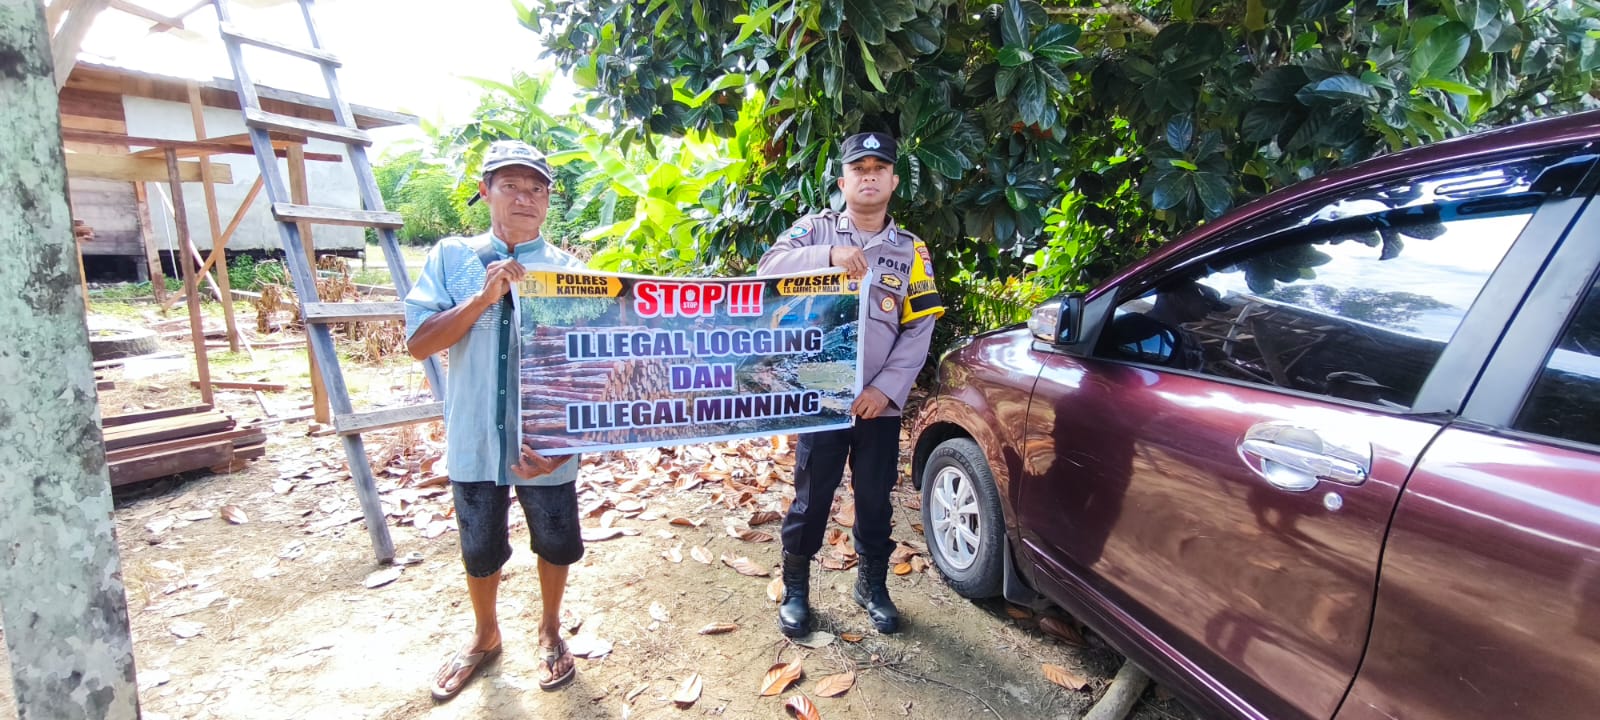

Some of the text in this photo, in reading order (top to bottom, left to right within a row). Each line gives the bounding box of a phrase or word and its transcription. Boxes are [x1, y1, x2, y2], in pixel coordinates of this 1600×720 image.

[877, 256, 910, 275] POLRI
[556, 273, 608, 286] POLRES
[783, 274, 840, 287] POLSEK
[556, 285, 608, 296] KATINGAN
[636, 281, 765, 317] STOP !!!
[682, 301, 698, 309] STOP
[567, 328, 822, 359] ILLEGAL LOGGING
[670, 364, 734, 391] DAN
[567, 391, 820, 431] ILLEGAL MINNING
